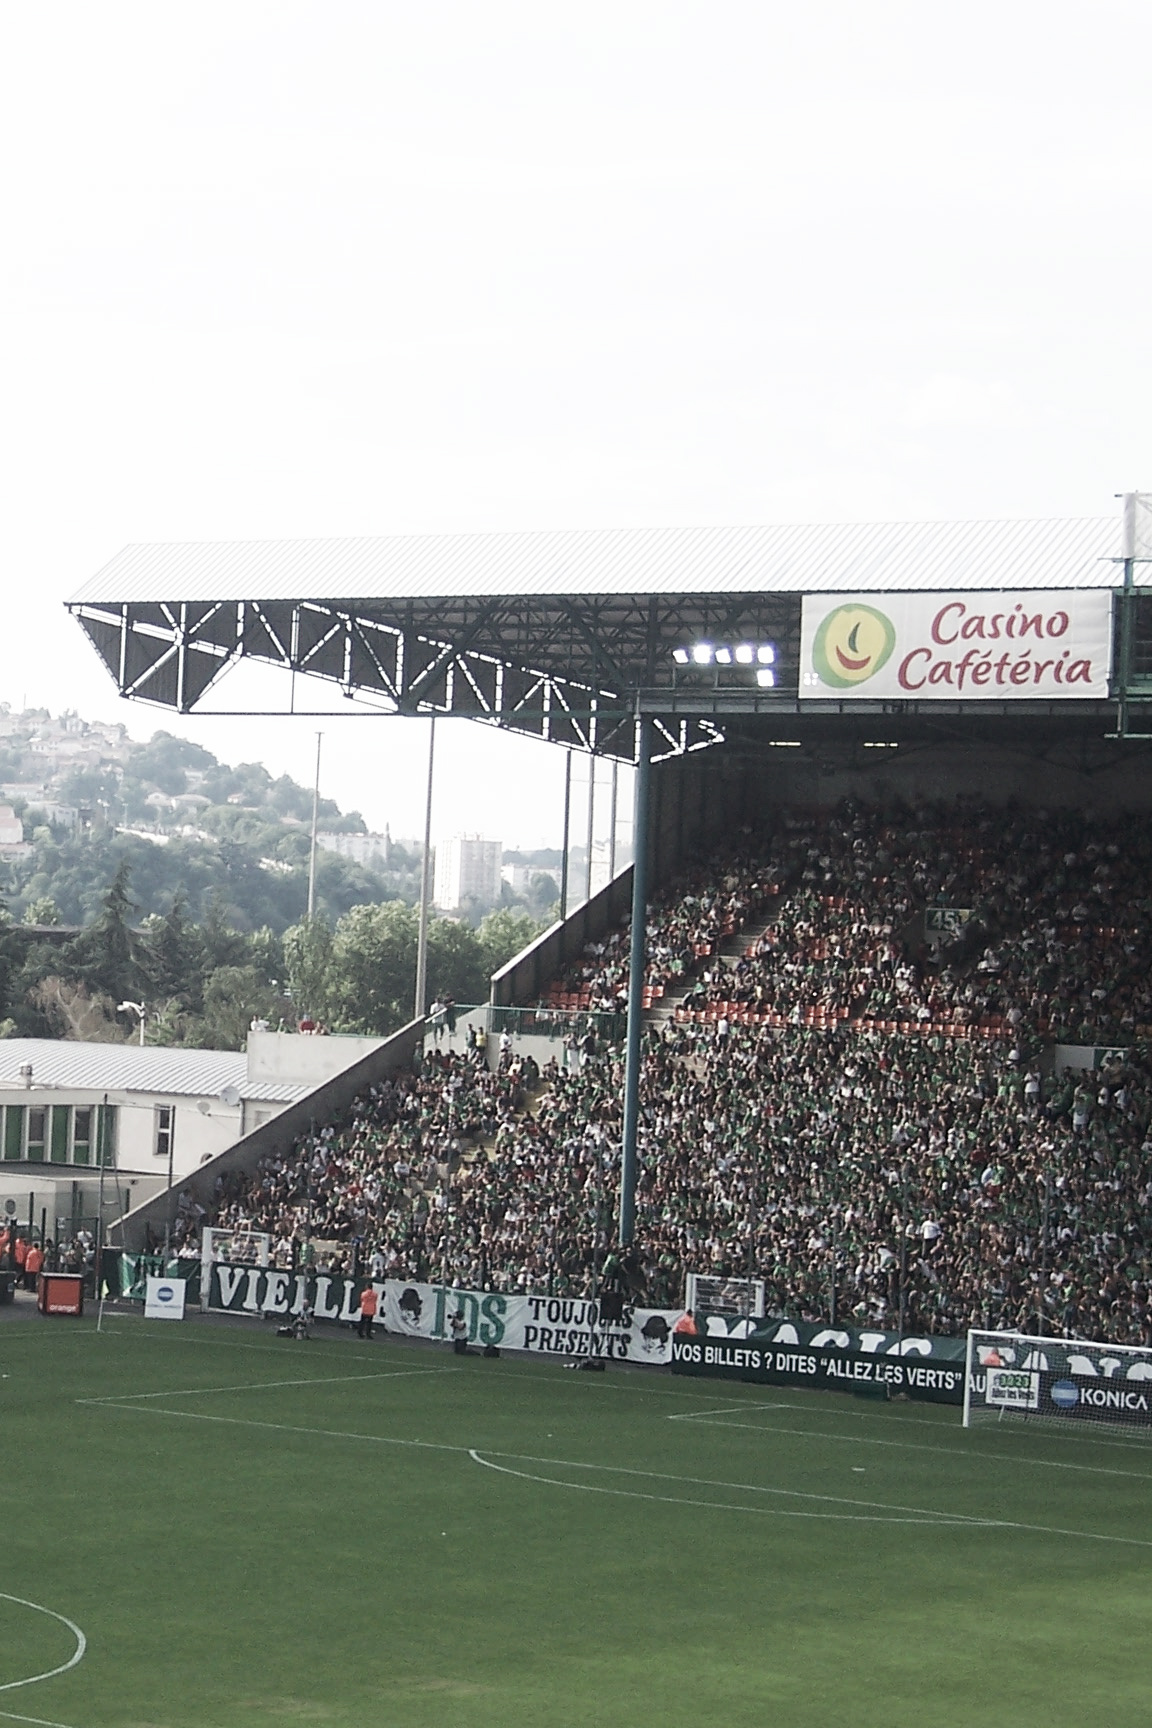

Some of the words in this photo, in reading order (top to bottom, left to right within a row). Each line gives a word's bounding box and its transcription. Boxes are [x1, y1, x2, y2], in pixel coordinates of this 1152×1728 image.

[931, 602, 1069, 645] Casino
[897, 648, 1093, 690] Cafétéria
[523, 1325, 632, 1357] PRESENTS
[673, 1342, 702, 1363] VOS
[705, 1345, 760, 1370] BILLETS
[764, 1353, 772, 1370] ?
[776, 1354, 816, 1375] DITES
[875, 1363, 903, 1384] LES
[1080, 1388, 1148, 1411] KONICA
